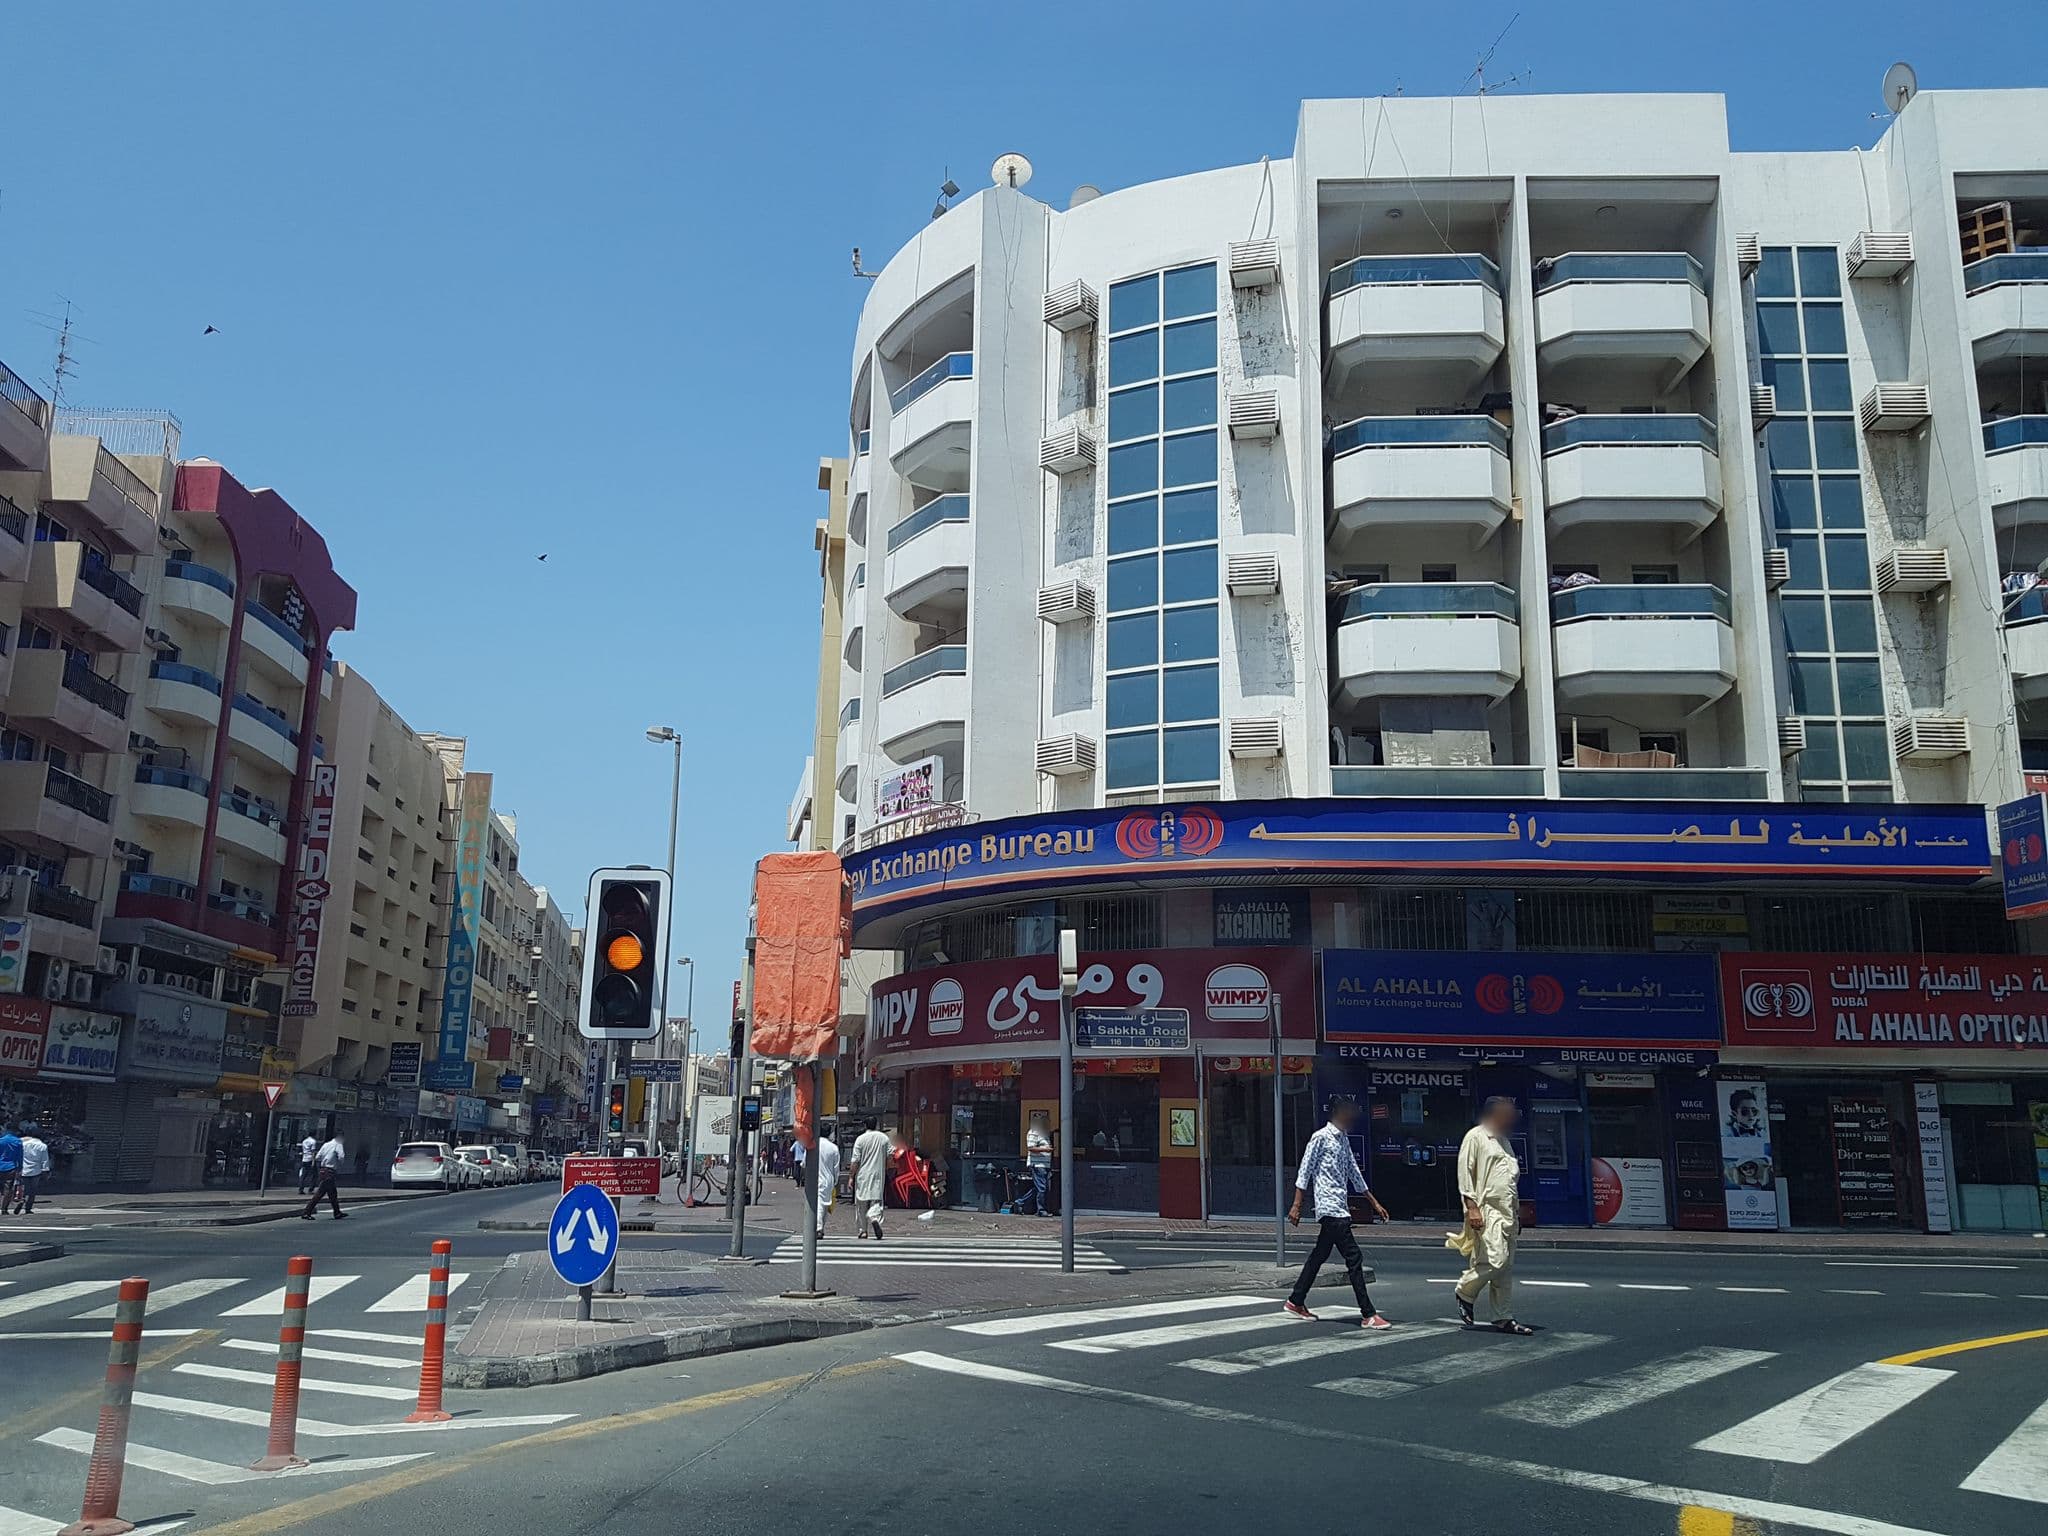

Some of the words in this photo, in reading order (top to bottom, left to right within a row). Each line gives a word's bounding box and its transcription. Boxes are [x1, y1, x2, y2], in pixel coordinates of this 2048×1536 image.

[303, 766, 335, 881] RED
[1788, 818, 1907, 853] الأهلية
[1915, 834, 1968, 847] مكتب
[871, 842, 972, 886] Exchange
[980, 827, 1094, 863] Bureau
[2008, 877, 2017, 888] AL
[1218, 903, 1234, 913] AL
[1238, 902, 1289, 912] AHALIA
[1216, 912, 1292, 939] EXCHANGE
[289, 899, 321, 1001] PALACE
[1337, 977, 1366, 993] AL
[1373, 978, 1462, 995] AHALIA
[1829, 964, 1910, 995] للنظارات
[1919, 965, 1982, 998] الأهلية
[1577, 976, 1661, 1001] الأهلية
[1989, 974, 2023, 1003] دبي
[445, 944, 471, 1055] HOTEL
[1206, 990, 1268, 1005] WIMPY
[1336, 997, 1371, 1008] Money
[1374, 998, 1423, 1009] Exchange
[1426, 999, 1463, 1009] Bureau
[1832, 995, 1868, 1008] DUBAI
[282, 1003, 315, 1015] HOTEL
[929, 1001, 963, 1020] WIMPY
[1140, 1010, 1187, 1026] شارع
[1078, 1025, 1091, 1035] Al
[1097, 1025, 1146, 1036] Sabkha
[1152, 1026, 1186, 1036] Road
[1835, 1013, 1864, 1041] AL
[1869, 1013, 1955, 1042] AHALIA
[2, 1036, 38, 1060] OPTIC
[1110, 1038, 1122, 1046] 116
[1144, 1038, 1161, 1047] 109
[1339, 1046, 1427, 1058] EXCHANGE
[1458, 1047, 1524, 1060] للصرافة
[1560, 1050, 1615, 1062] BUREAU
[1618, 1052, 1637, 1062] DE
[1640, 1052, 1695, 1064] CHANGE
[1372, 1072, 1464, 1086] EXCHANGE
[1681, 1100, 1704, 1108] WAGE
[1676, 1112, 1712, 1120] PAYMENT
[1837, 1148, 1863, 1160] Dior
